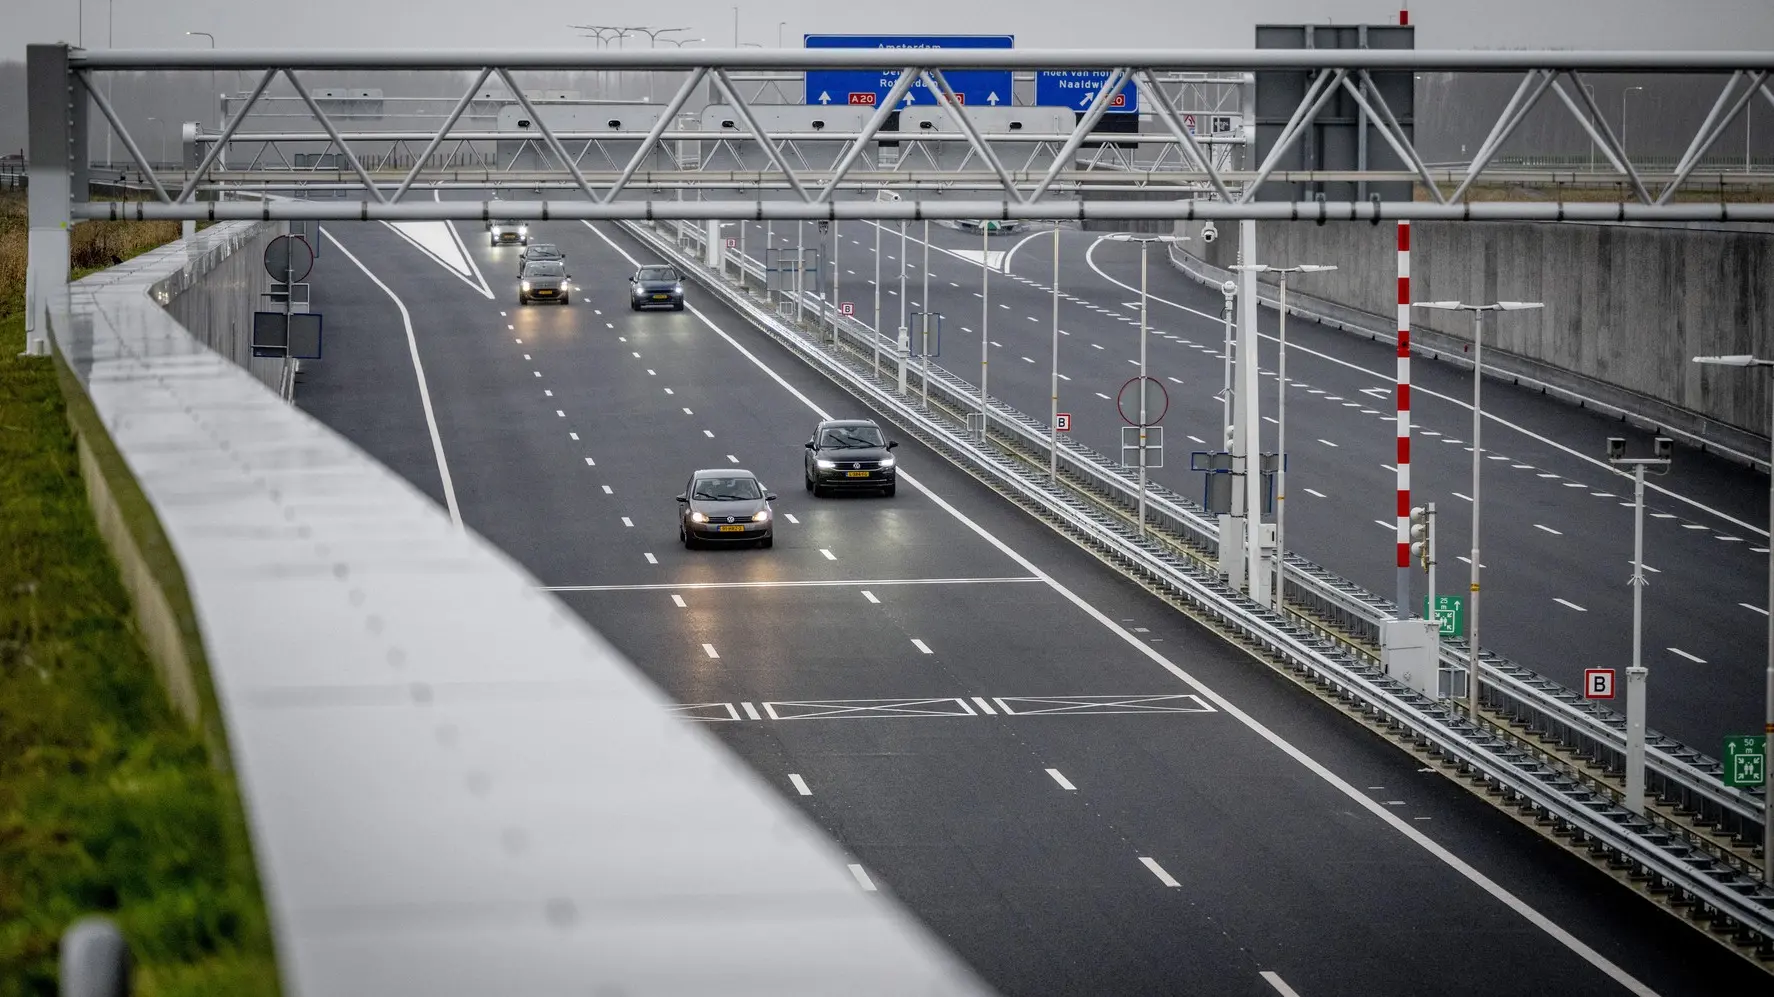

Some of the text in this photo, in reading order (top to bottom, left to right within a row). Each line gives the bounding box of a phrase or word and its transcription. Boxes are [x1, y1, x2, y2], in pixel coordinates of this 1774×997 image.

[1058, 417, 1066, 428] B
[1594, 675, 1606, 692] B
[1744, 738, 1755, 747] 50
